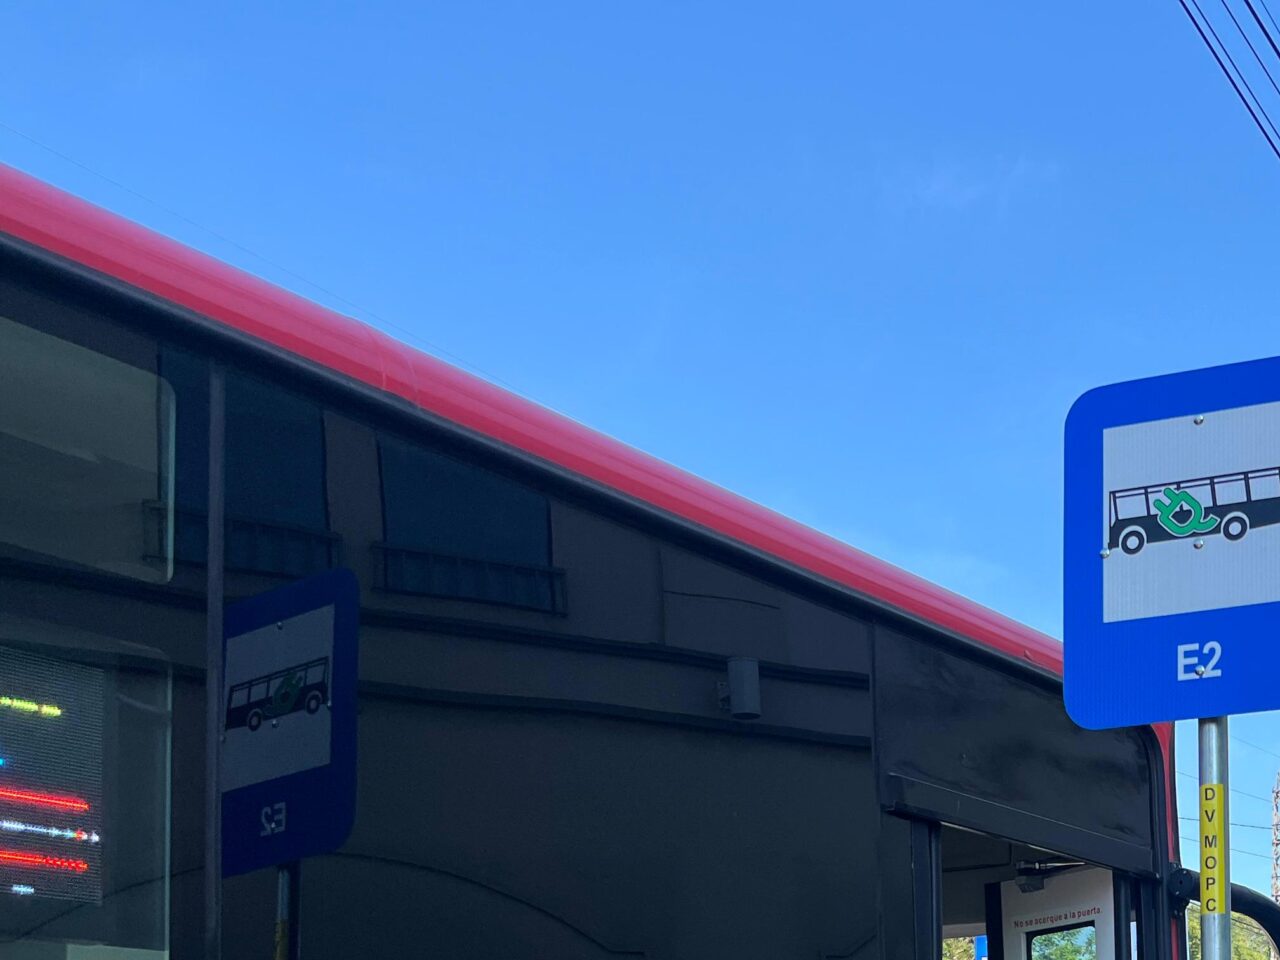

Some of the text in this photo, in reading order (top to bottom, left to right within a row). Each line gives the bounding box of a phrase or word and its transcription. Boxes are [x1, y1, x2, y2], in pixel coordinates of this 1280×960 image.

[1177, 640, 1222, 681] E2
[1014, 920, 1024, 928] No
[1025, 919, 1033, 927] se
[1034, 913, 1062, 925] acerque
[1069, 911, 1076, 919] la
